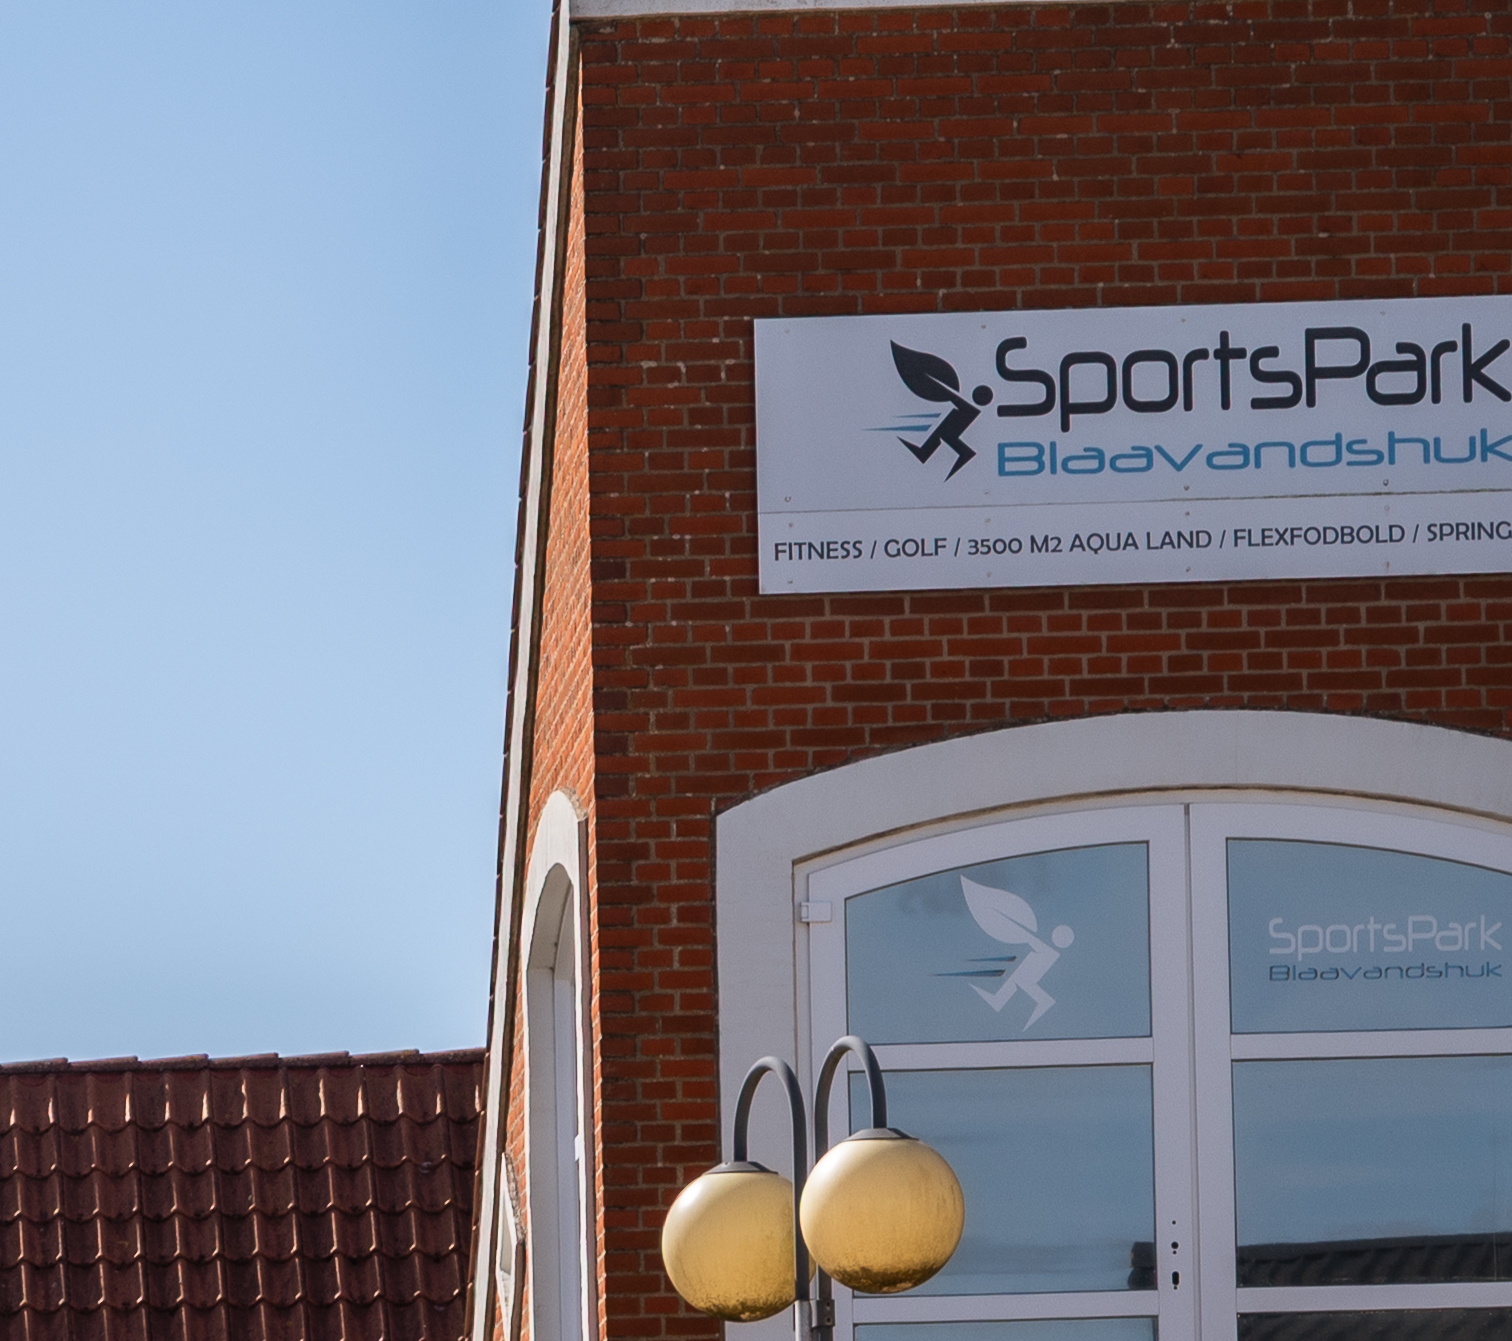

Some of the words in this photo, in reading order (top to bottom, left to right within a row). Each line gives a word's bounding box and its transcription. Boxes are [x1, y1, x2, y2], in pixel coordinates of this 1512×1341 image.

[995, 323, 1512, 432] SportsPark
[997, 428, 1512, 477] Blaavandshuk
[774, 540, 864, 562] FITNESS
[884, 537, 948, 559] GOLF
[967, 536, 1023, 557] 3500
[1030, 534, 1063, 555] M2
[1069, 531, 1141, 556] AQUA
[1147, 529, 1213, 552] LAND
[1233, 524, 1406, 549] FLEXFODBOLD
[1427, 520, 1512, 543] SPRING
[1268, 915, 1503, 961] SportsPark
[1268, 961, 1503, 982] Blaavandshuk
